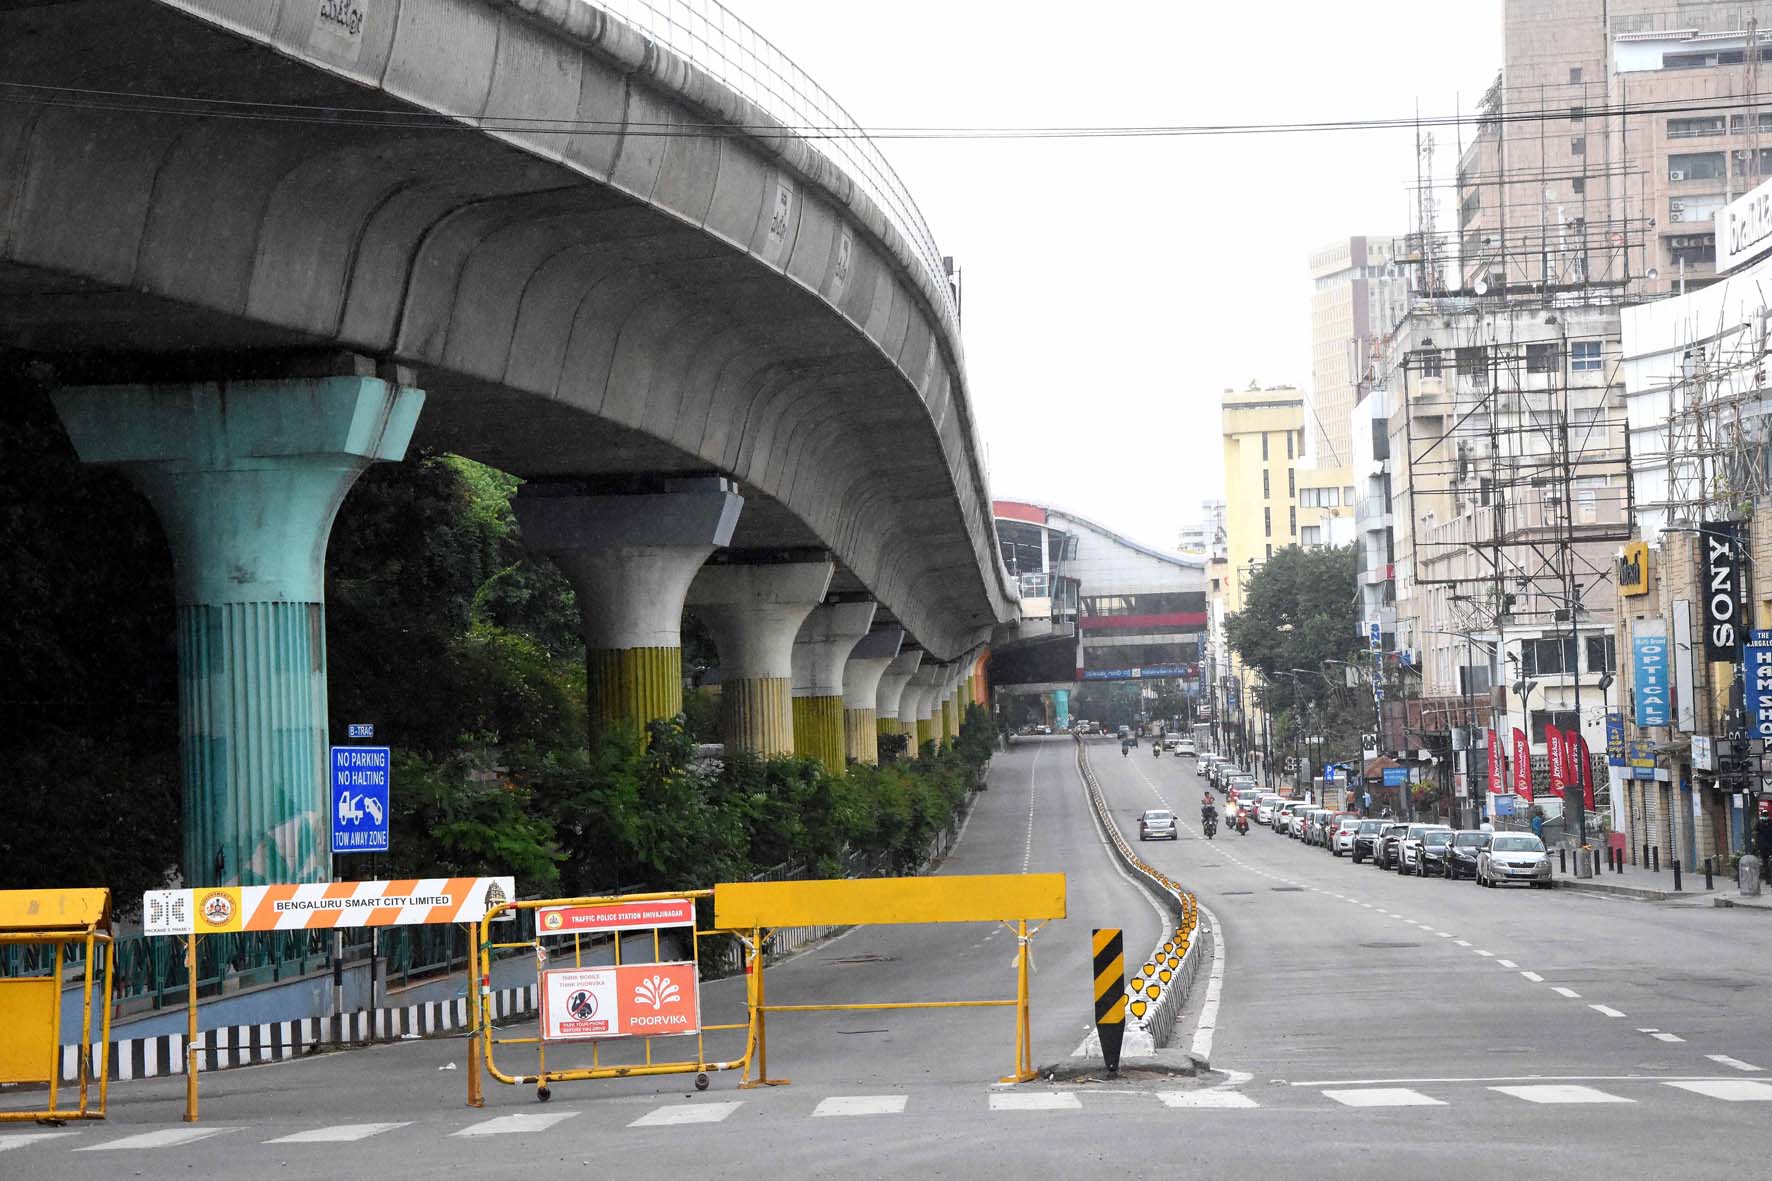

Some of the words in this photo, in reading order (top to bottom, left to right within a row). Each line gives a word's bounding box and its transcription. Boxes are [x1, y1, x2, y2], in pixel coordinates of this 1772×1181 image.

[1709, 536, 1735, 647] SONY
[1756, 652, 1772, 690] HAM
[1641, 645, 1664, 725] OPTICALS
[349, 726, 374, 736] B-TRAC
[337, 752, 350, 767] NO
[351, 752, 385, 767] PARKING
[338, 771, 351, 785] NO
[352, 771, 385, 785] HALTING
[335, 831, 349, 846] TOW
[350, 831, 368, 846] AWAY
[369, 831, 387, 845] ZONE
[276, 899, 342, 911] BENGALURU
[345, 897, 381, 908] SMART
[383, 897, 407, 907] CITY
[409, 896, 450, 906] LIMITED
[571, 914, 596, 923] TRAFFIC
[597, 913, 617, 922] POLICE
[618, 912, 641, 921] STATION
[642, 910, 683, 919] SHIVAJINAGAR
[630, 1015, 688, 1026] POORVIKA
